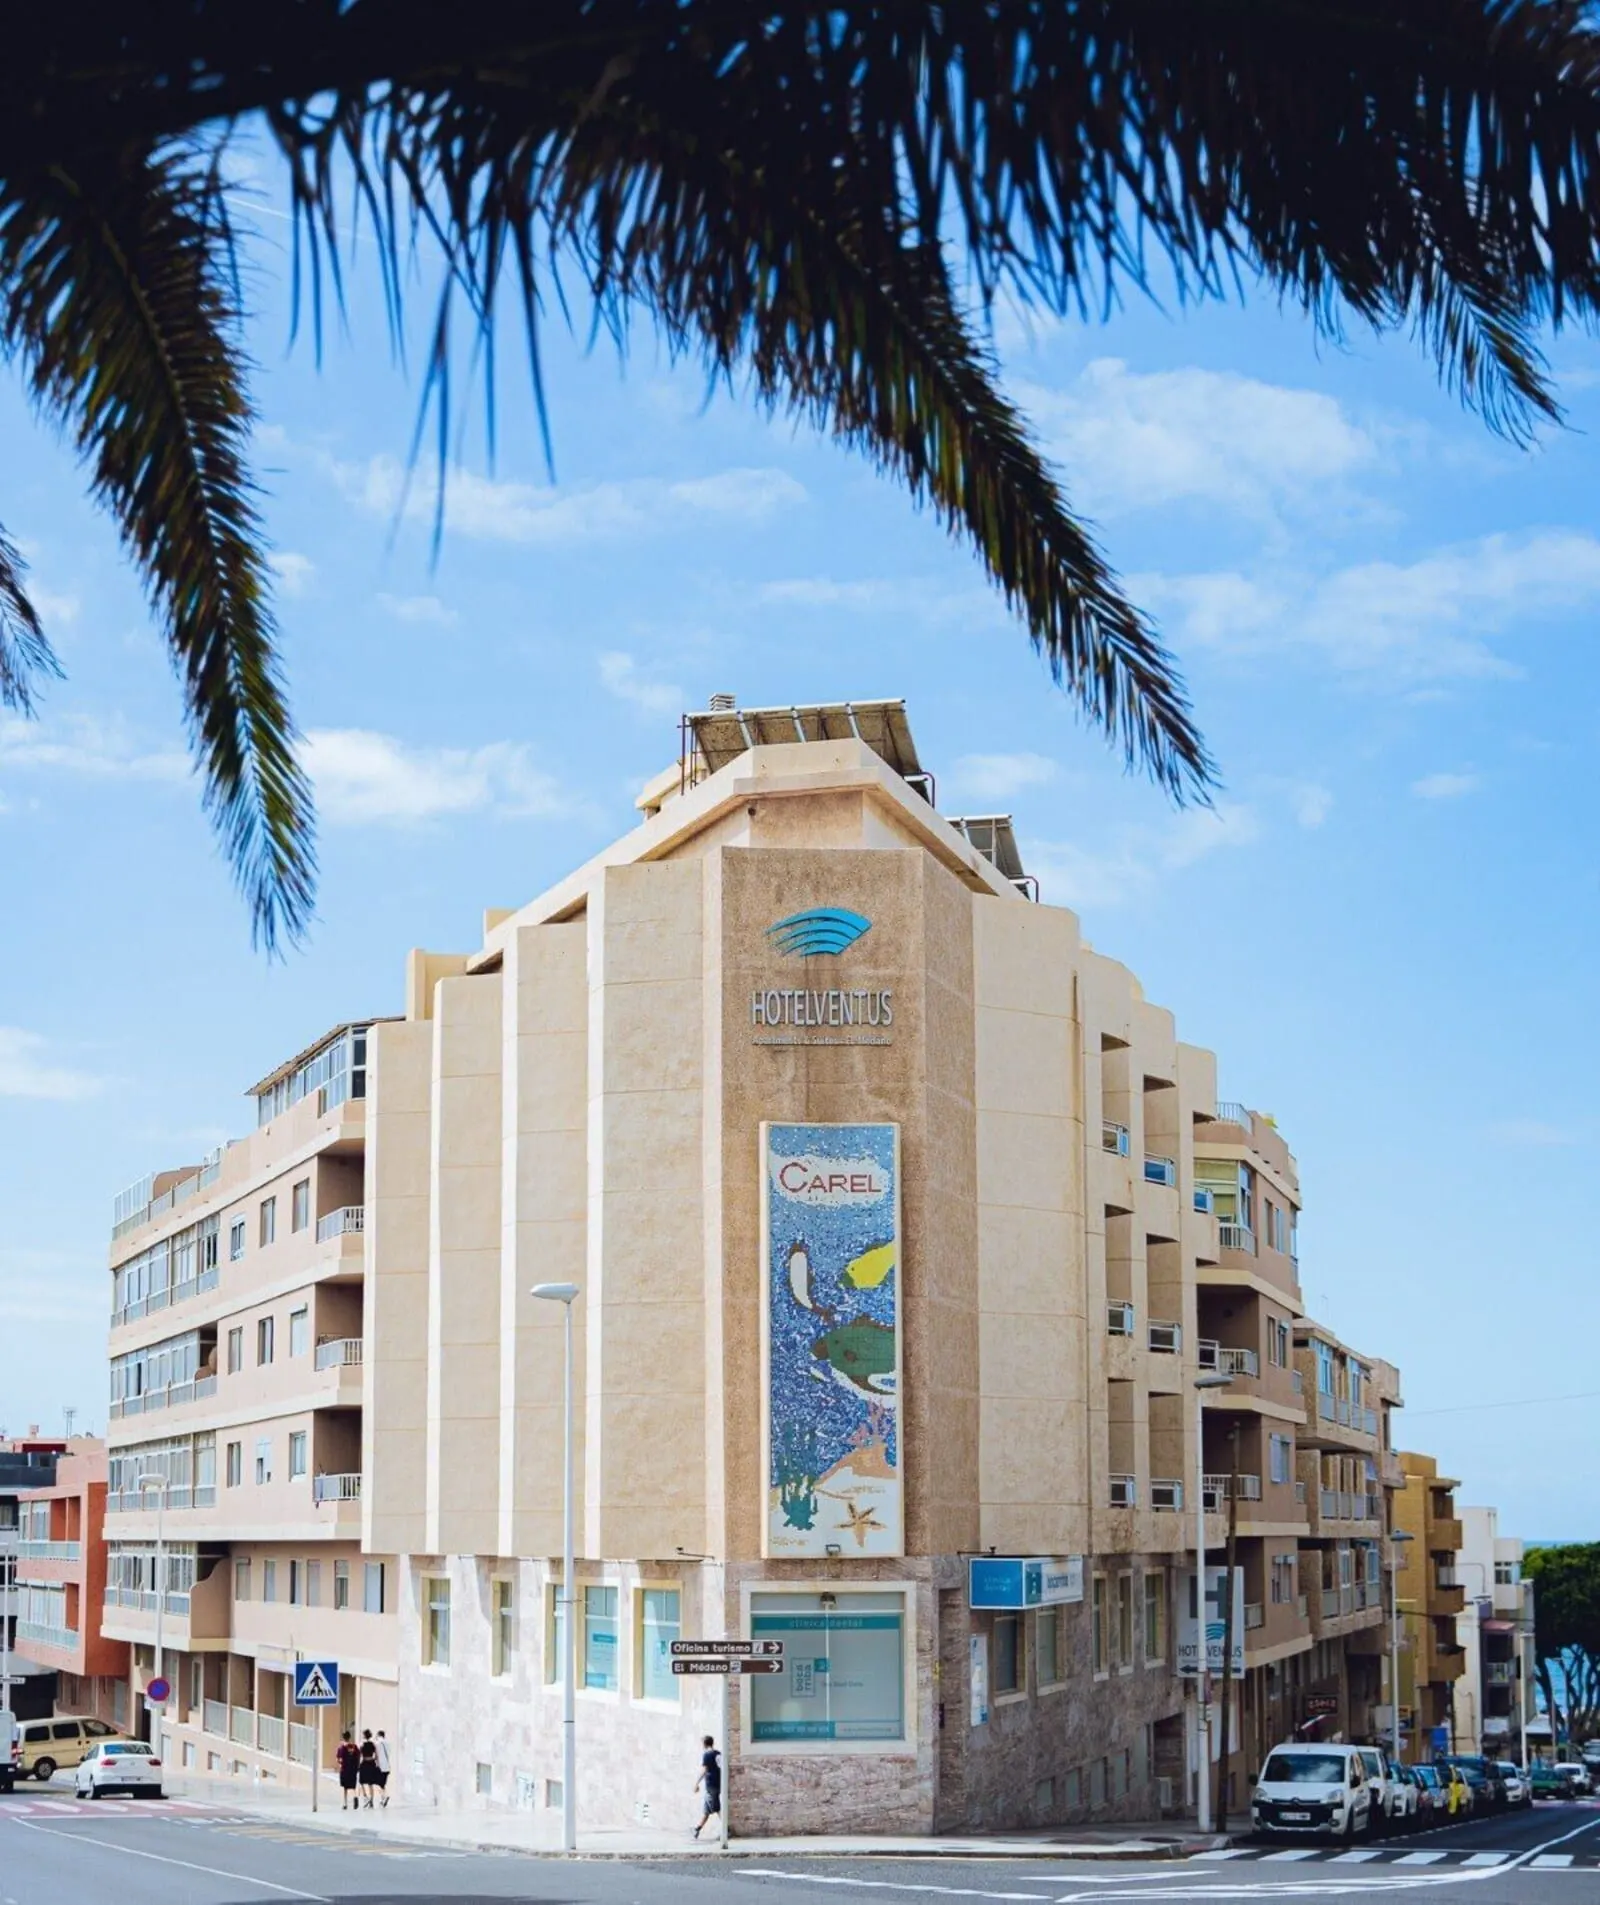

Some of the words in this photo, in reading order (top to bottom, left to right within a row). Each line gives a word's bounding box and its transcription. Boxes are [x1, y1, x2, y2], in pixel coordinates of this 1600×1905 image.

[752, 989, 892, 1026] HOTELVENTUS
[779, 1161, 882, 1194] CAREL
[673, 1643, 709, 1653] Oficina
[712, 1643, 751, 1653] turismo
[674, 1663, 685, 1672] El
